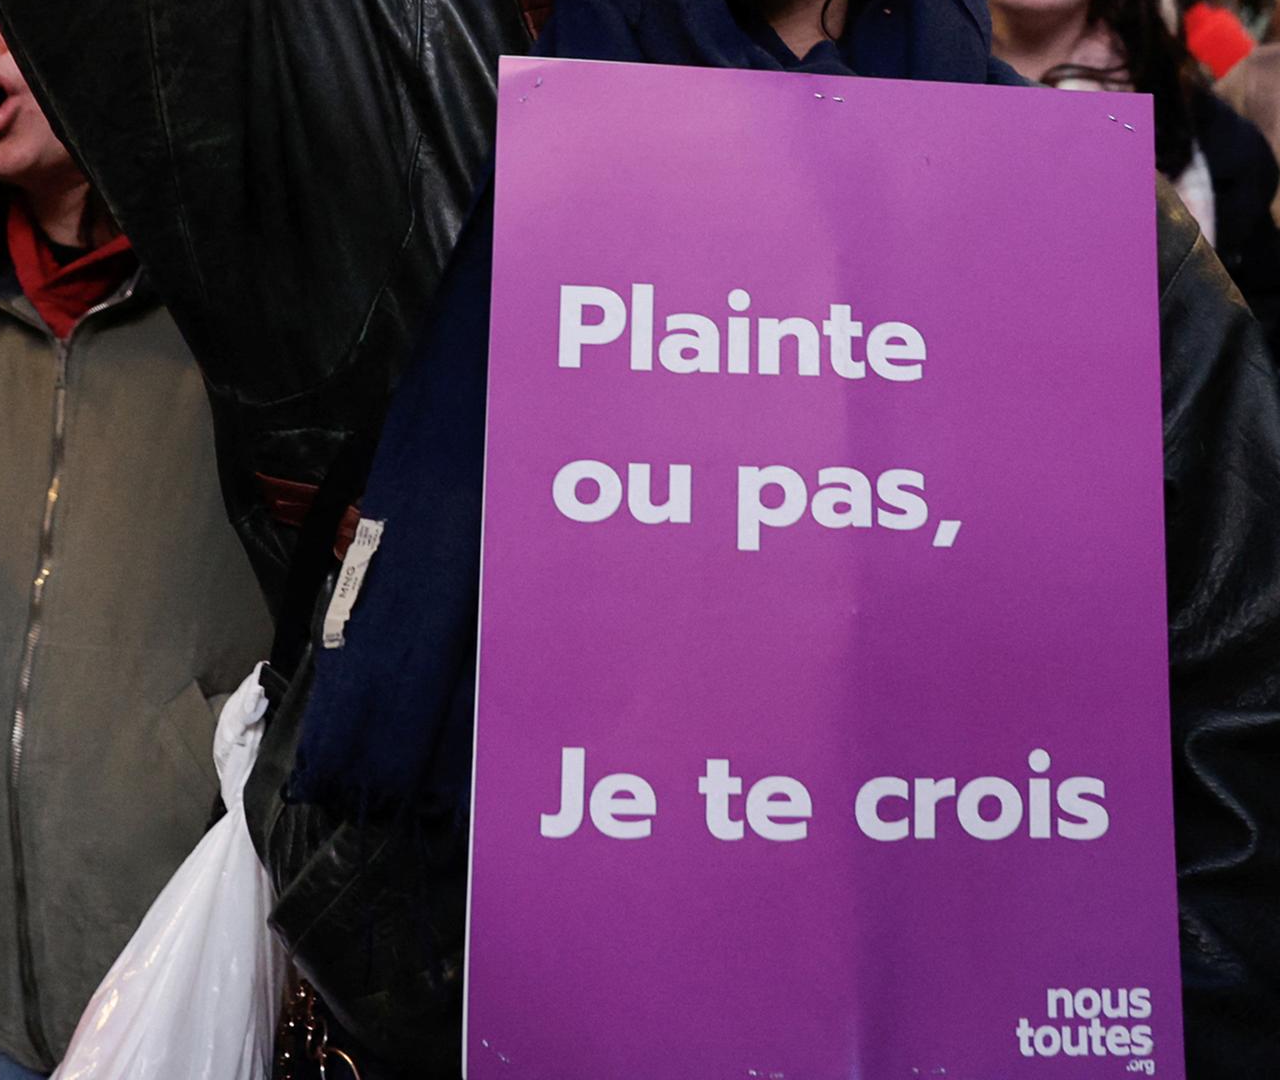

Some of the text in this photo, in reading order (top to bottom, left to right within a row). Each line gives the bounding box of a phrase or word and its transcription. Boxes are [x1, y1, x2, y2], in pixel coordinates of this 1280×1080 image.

[558, 283, 927, 382] Plainte
[552, 458, 962, 551] ou pas,
[540, 747, 1110, 842] Je te crois
[1047, 987, 1152, 1019] nous
[1015, 1017, 1154, 1056] toutes
[1126, 1059, 1155, 1076] .org
